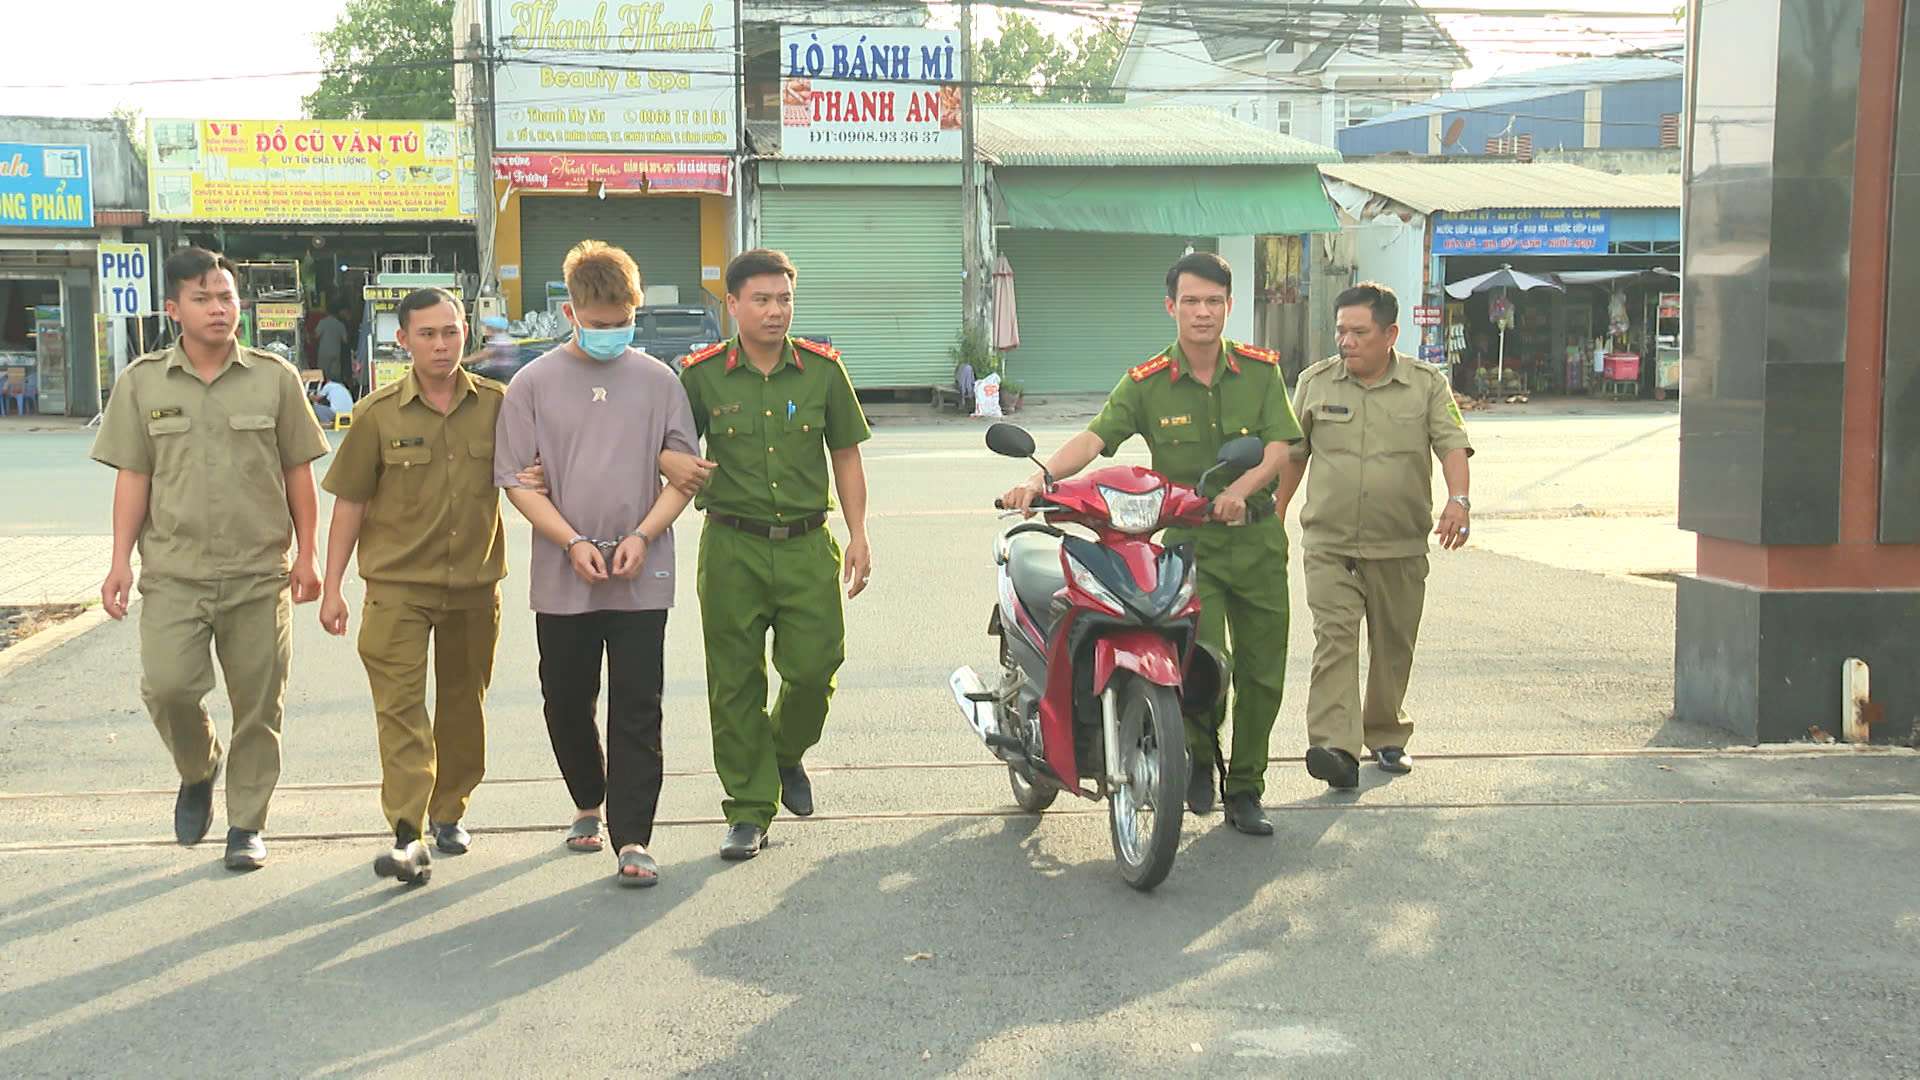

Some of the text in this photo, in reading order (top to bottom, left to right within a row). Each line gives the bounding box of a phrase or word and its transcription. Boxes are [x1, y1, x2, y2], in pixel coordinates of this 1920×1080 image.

[511, 1, 717, 53] Thanh Thanh
[789, 33, 954, 80] LÒ BÁNH MÌ
[540, 66, 691, 93] Beauty & Spa
[810, 91, 941, 122] THANH AN
[209, 122, 243, 136] VT
[255, 124, 418, 153] ĐỒ CŨ VĂN TÚ
[281, 156, 292, 164] UY
[0, 179, 83, 221] NG PHẨM
[102, 248, 144, 279] PHÔ
[112, 282, 138, 314] TÔ
